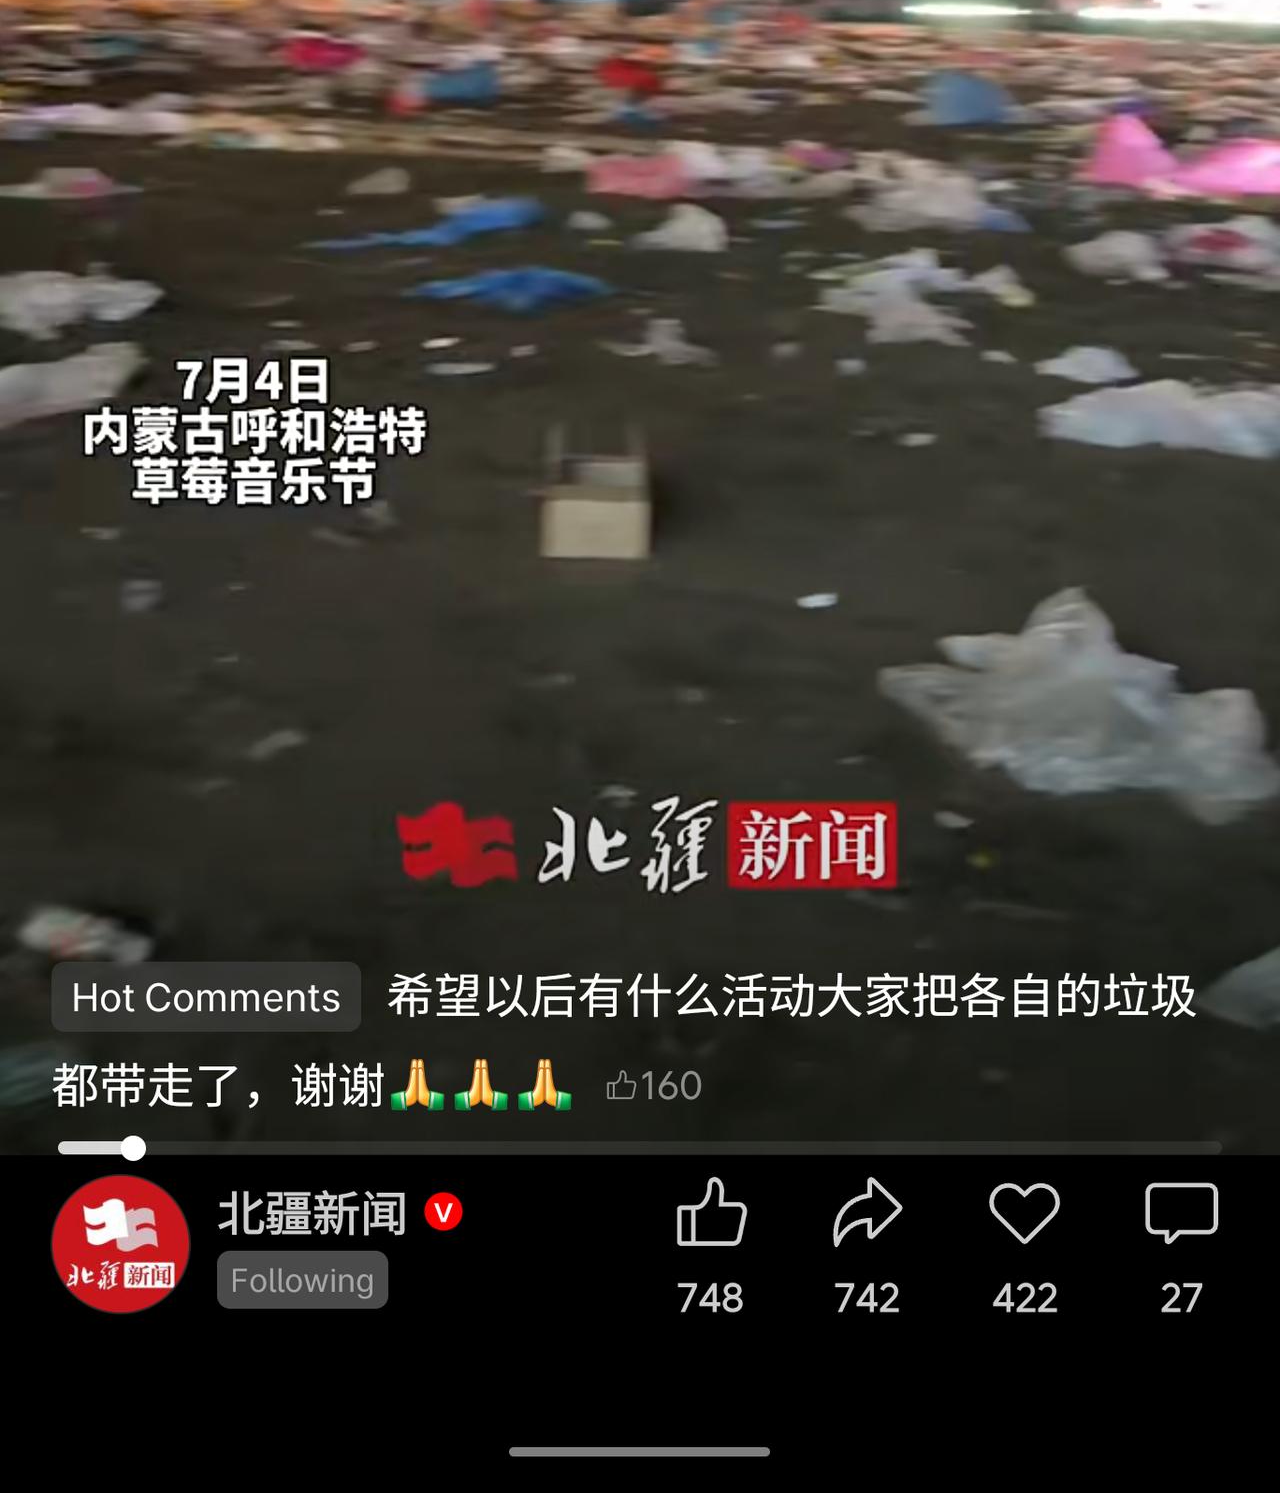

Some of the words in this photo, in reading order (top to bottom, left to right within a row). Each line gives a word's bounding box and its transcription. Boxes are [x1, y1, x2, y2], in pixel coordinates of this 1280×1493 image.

[73, 982, 135, 1013] Hot
[145, 982, 340, 1013] Comments
[388, 972, 1196, 1019] 希望以后有什么活动大家把各自的垃圾
[641, 1070, 702, 1101] 160
[217, 1189, 406, 1236] 北疆新闻
[232, 1267, 374, 1300] Following
[677, 1282, 744, 1313] 748
[834, 1282, 900, 1313] 742
[992, 1282, 1058, 1313] 422
[1161, 1282, 1203, 1313] 27
